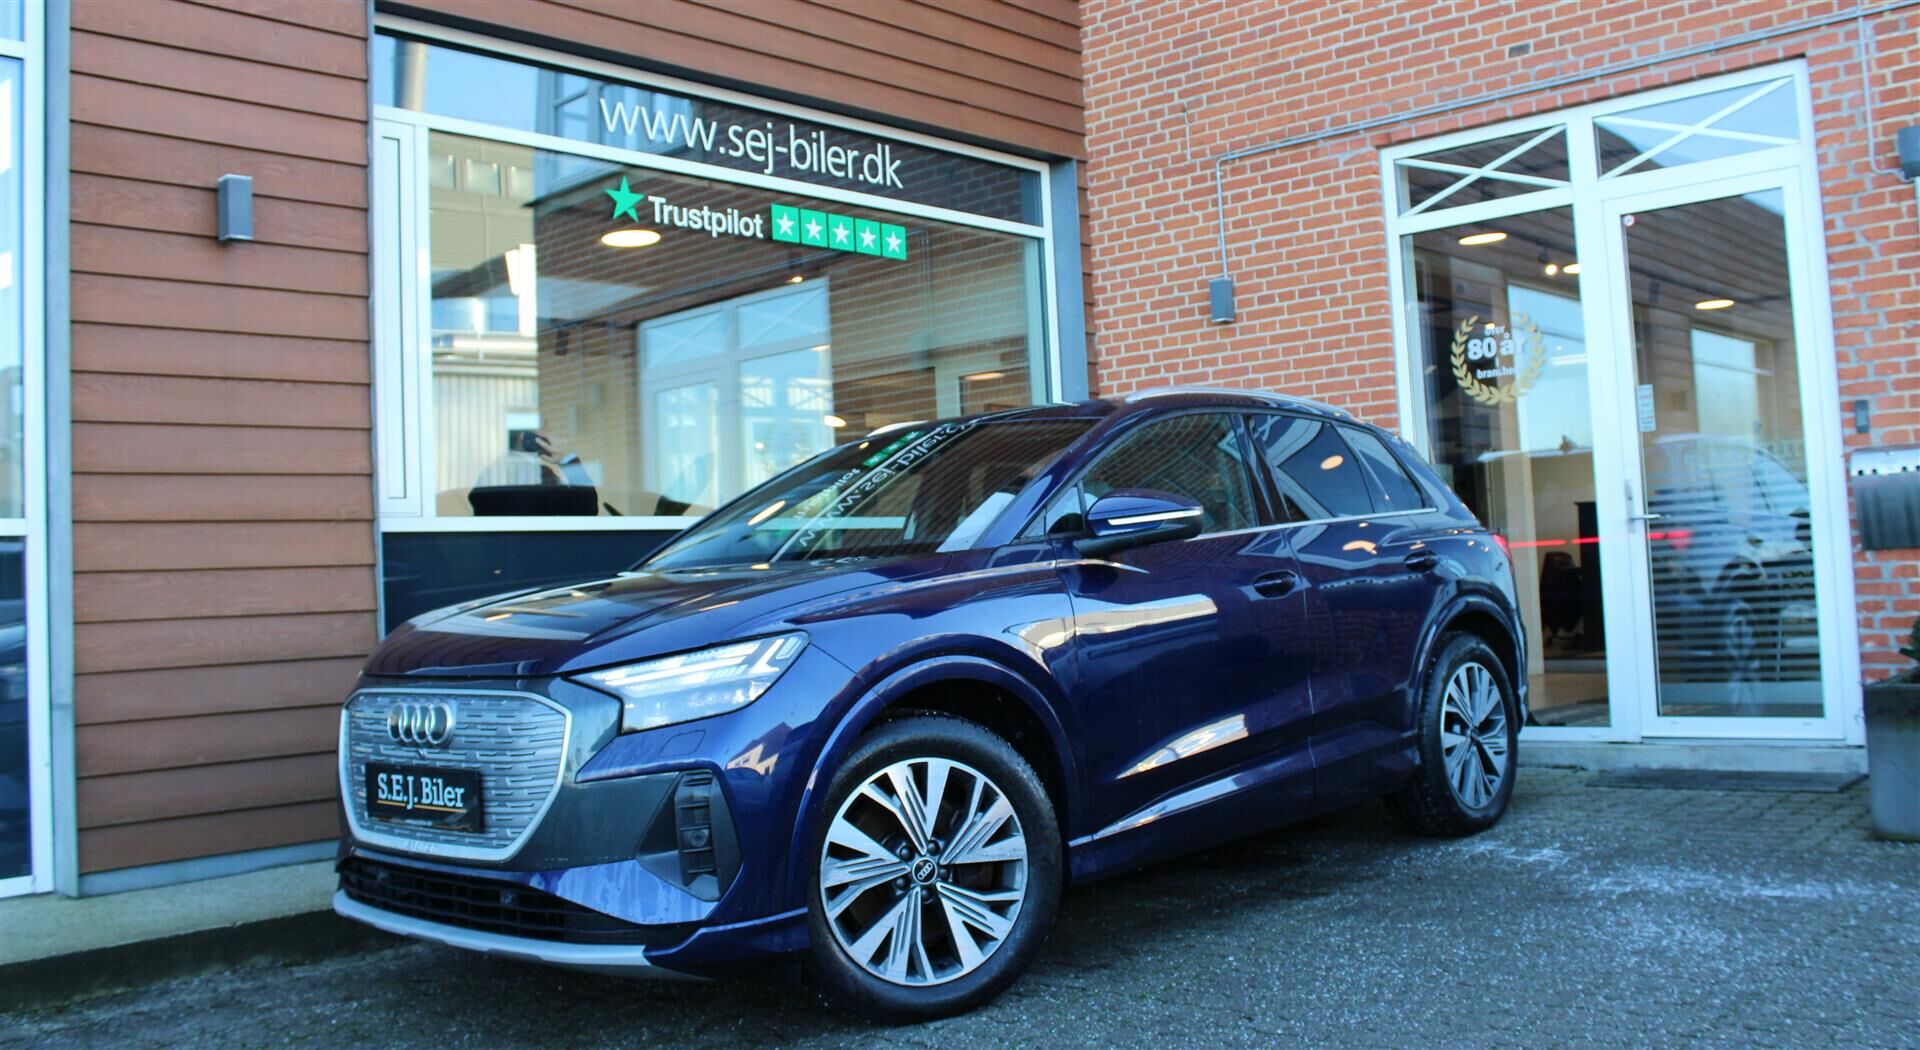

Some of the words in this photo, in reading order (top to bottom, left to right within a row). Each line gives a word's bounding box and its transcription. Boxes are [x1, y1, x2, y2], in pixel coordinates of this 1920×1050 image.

[600, 98, 904, 189] www.sej-biler.dk
[648, 195, 764, 239] Trustpilot
[1467, 337, 1497, 360] 80
[377, 772, 418, 810] S.E.J.
[420, 777, 465, 808] Biler
